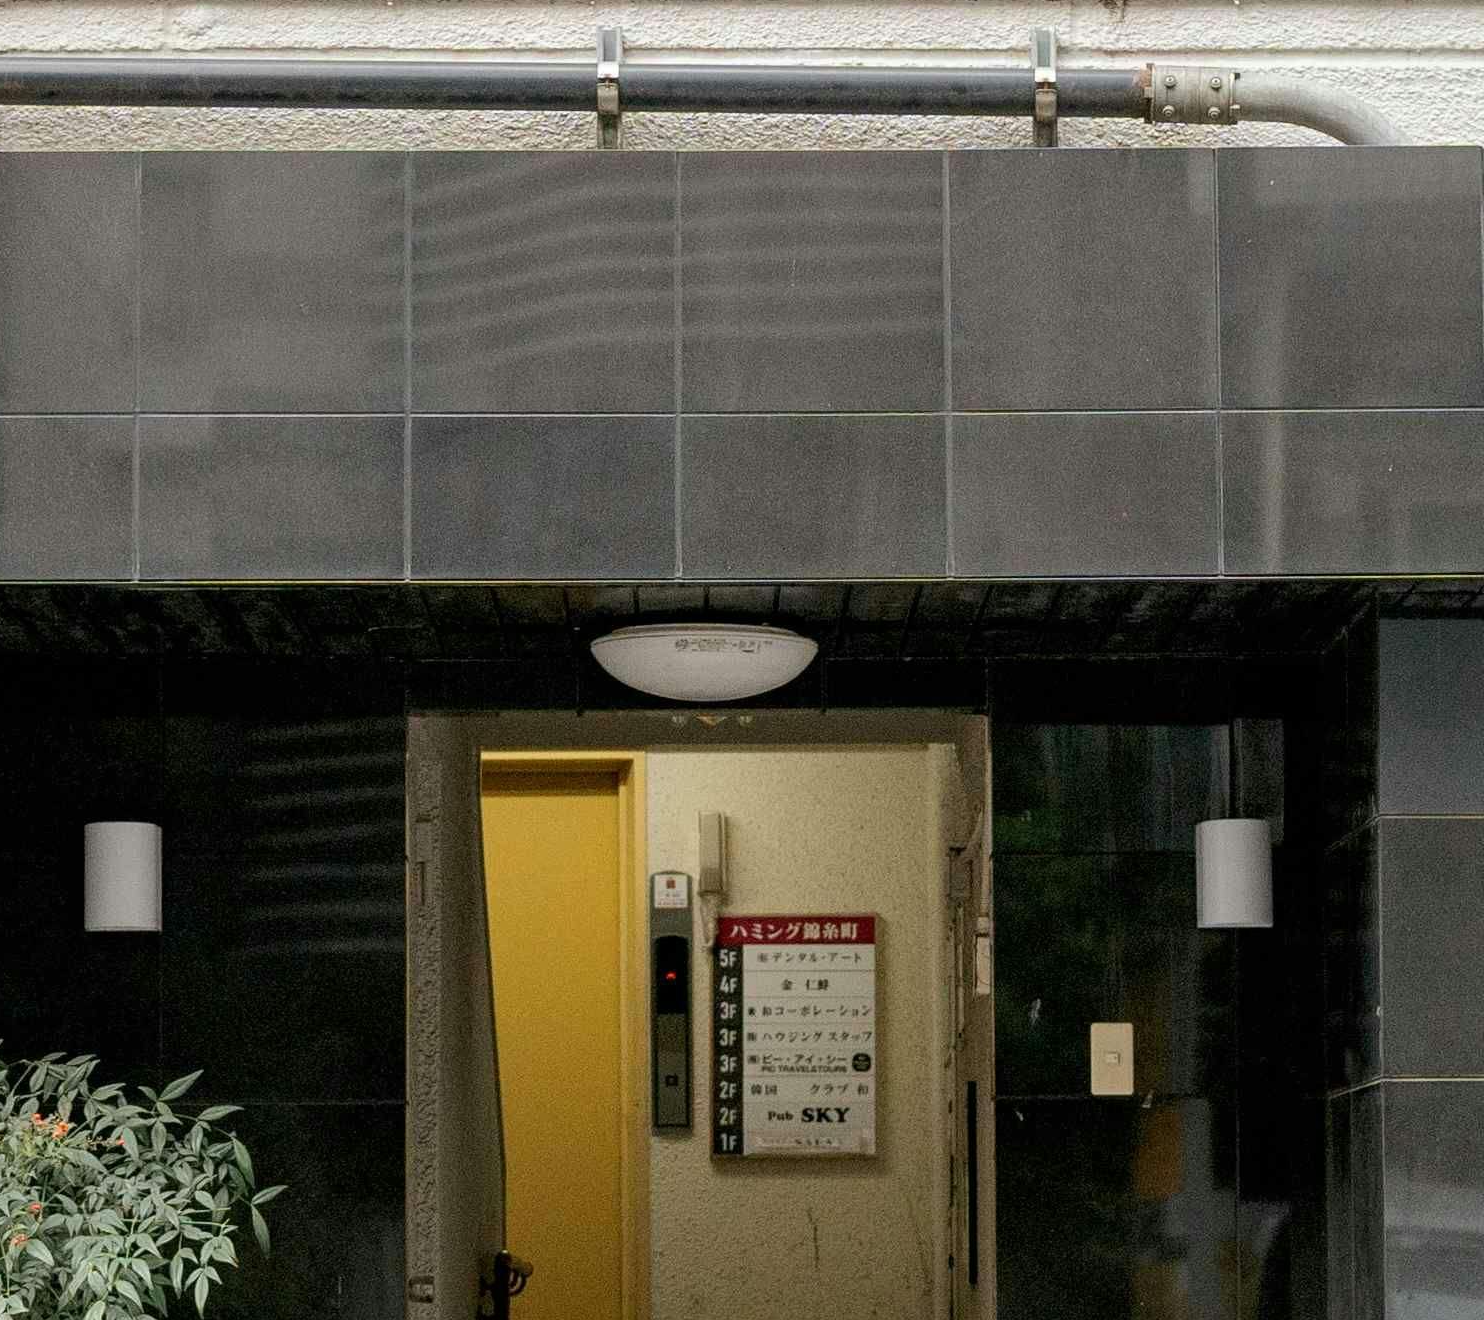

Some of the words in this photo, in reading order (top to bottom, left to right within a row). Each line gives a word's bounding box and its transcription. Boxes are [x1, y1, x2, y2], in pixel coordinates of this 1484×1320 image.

[729, 922, 859, 940] ハミング錦糸町
[719, 949, 737, 968] 5F
[720, 975, 738, 993] 4F
[720, 1002, 737, 1019] 3F
[719, 1029, 737, 1046] 3F
[719, 1055, 737, 1072] 3F
[719, 1081, 737, 1099] 2F
[750, 1084, 778, 1095] 韓国
[810, 1084, 850, 1095] クラブ
[719, 1107, 737, 1125] 2F
[767, 1111, 794, 1122] Pub
[801, 1107, 850, 1123] SKY
[721, 1133, 737, 1151] 1F
